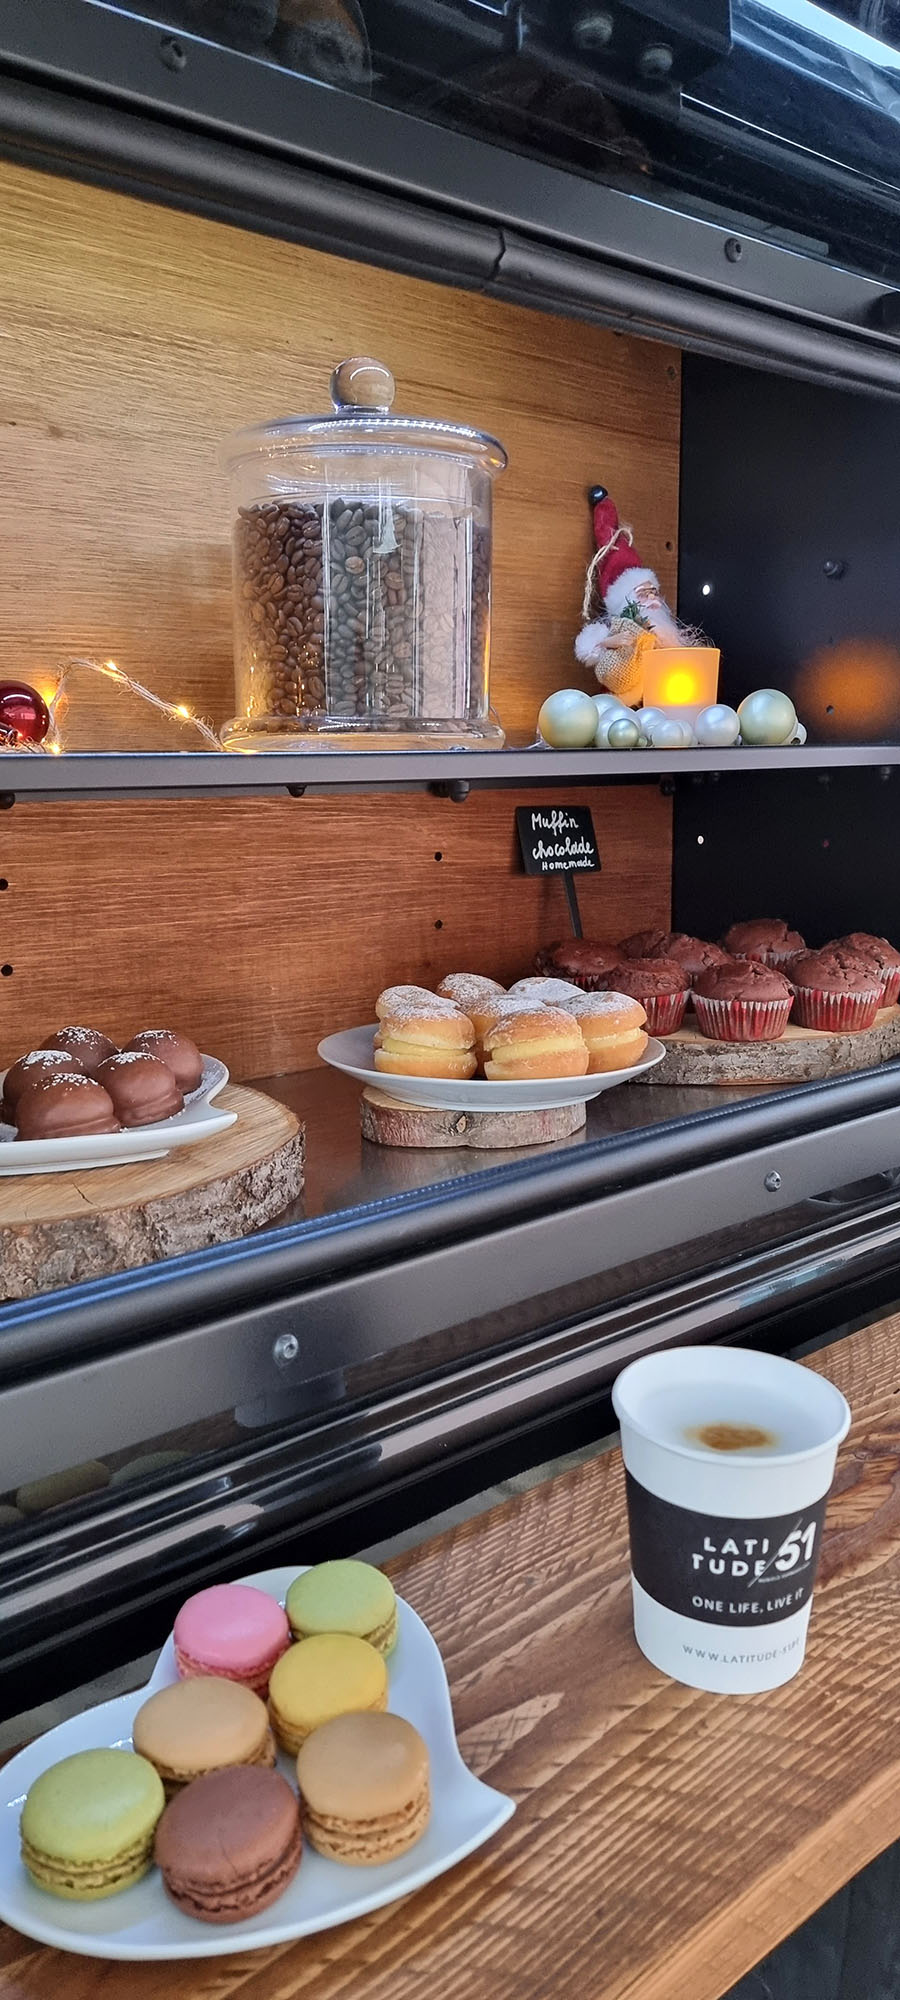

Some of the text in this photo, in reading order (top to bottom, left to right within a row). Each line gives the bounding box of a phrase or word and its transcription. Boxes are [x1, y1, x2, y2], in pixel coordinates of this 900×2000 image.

[531, 810, 579, 836] Muffin
[532, 836, 594, 860] chocolade
[542, 855, 595, 871] Homemade
[703, 1536, 769, 1555] LATI
[774, 1521, 816, 1571] 51
[692, 1553, 766, 1577] TUDE
[692, 1587, 804, 1614] ONE LIFE, LIVE IT
